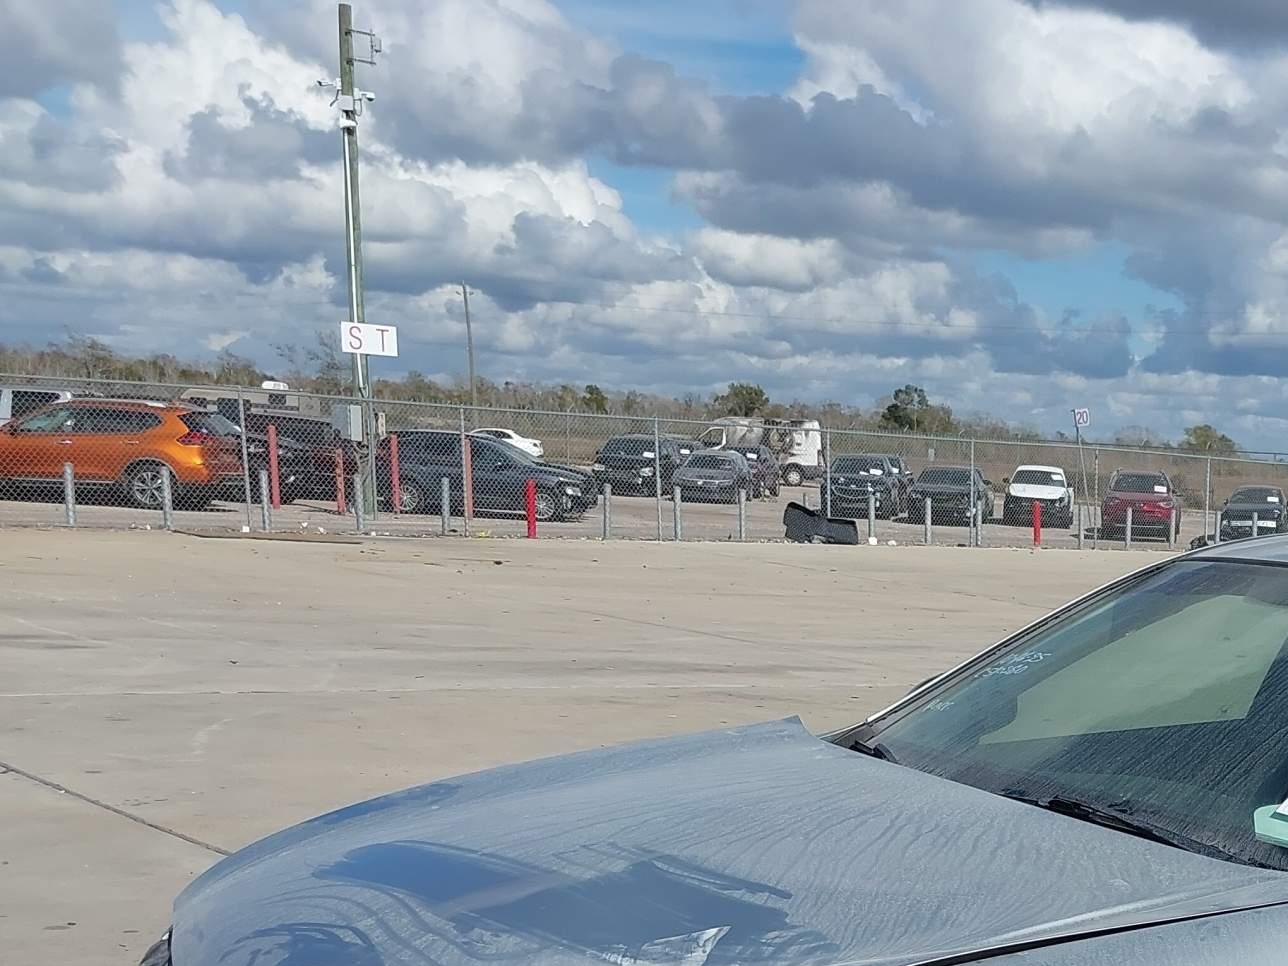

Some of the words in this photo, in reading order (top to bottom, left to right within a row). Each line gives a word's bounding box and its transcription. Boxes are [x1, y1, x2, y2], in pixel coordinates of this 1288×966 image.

[349, 325, 363, 350] S
[375, 328, 390, 352] T
[1076, 410, 1089, 425] 20
